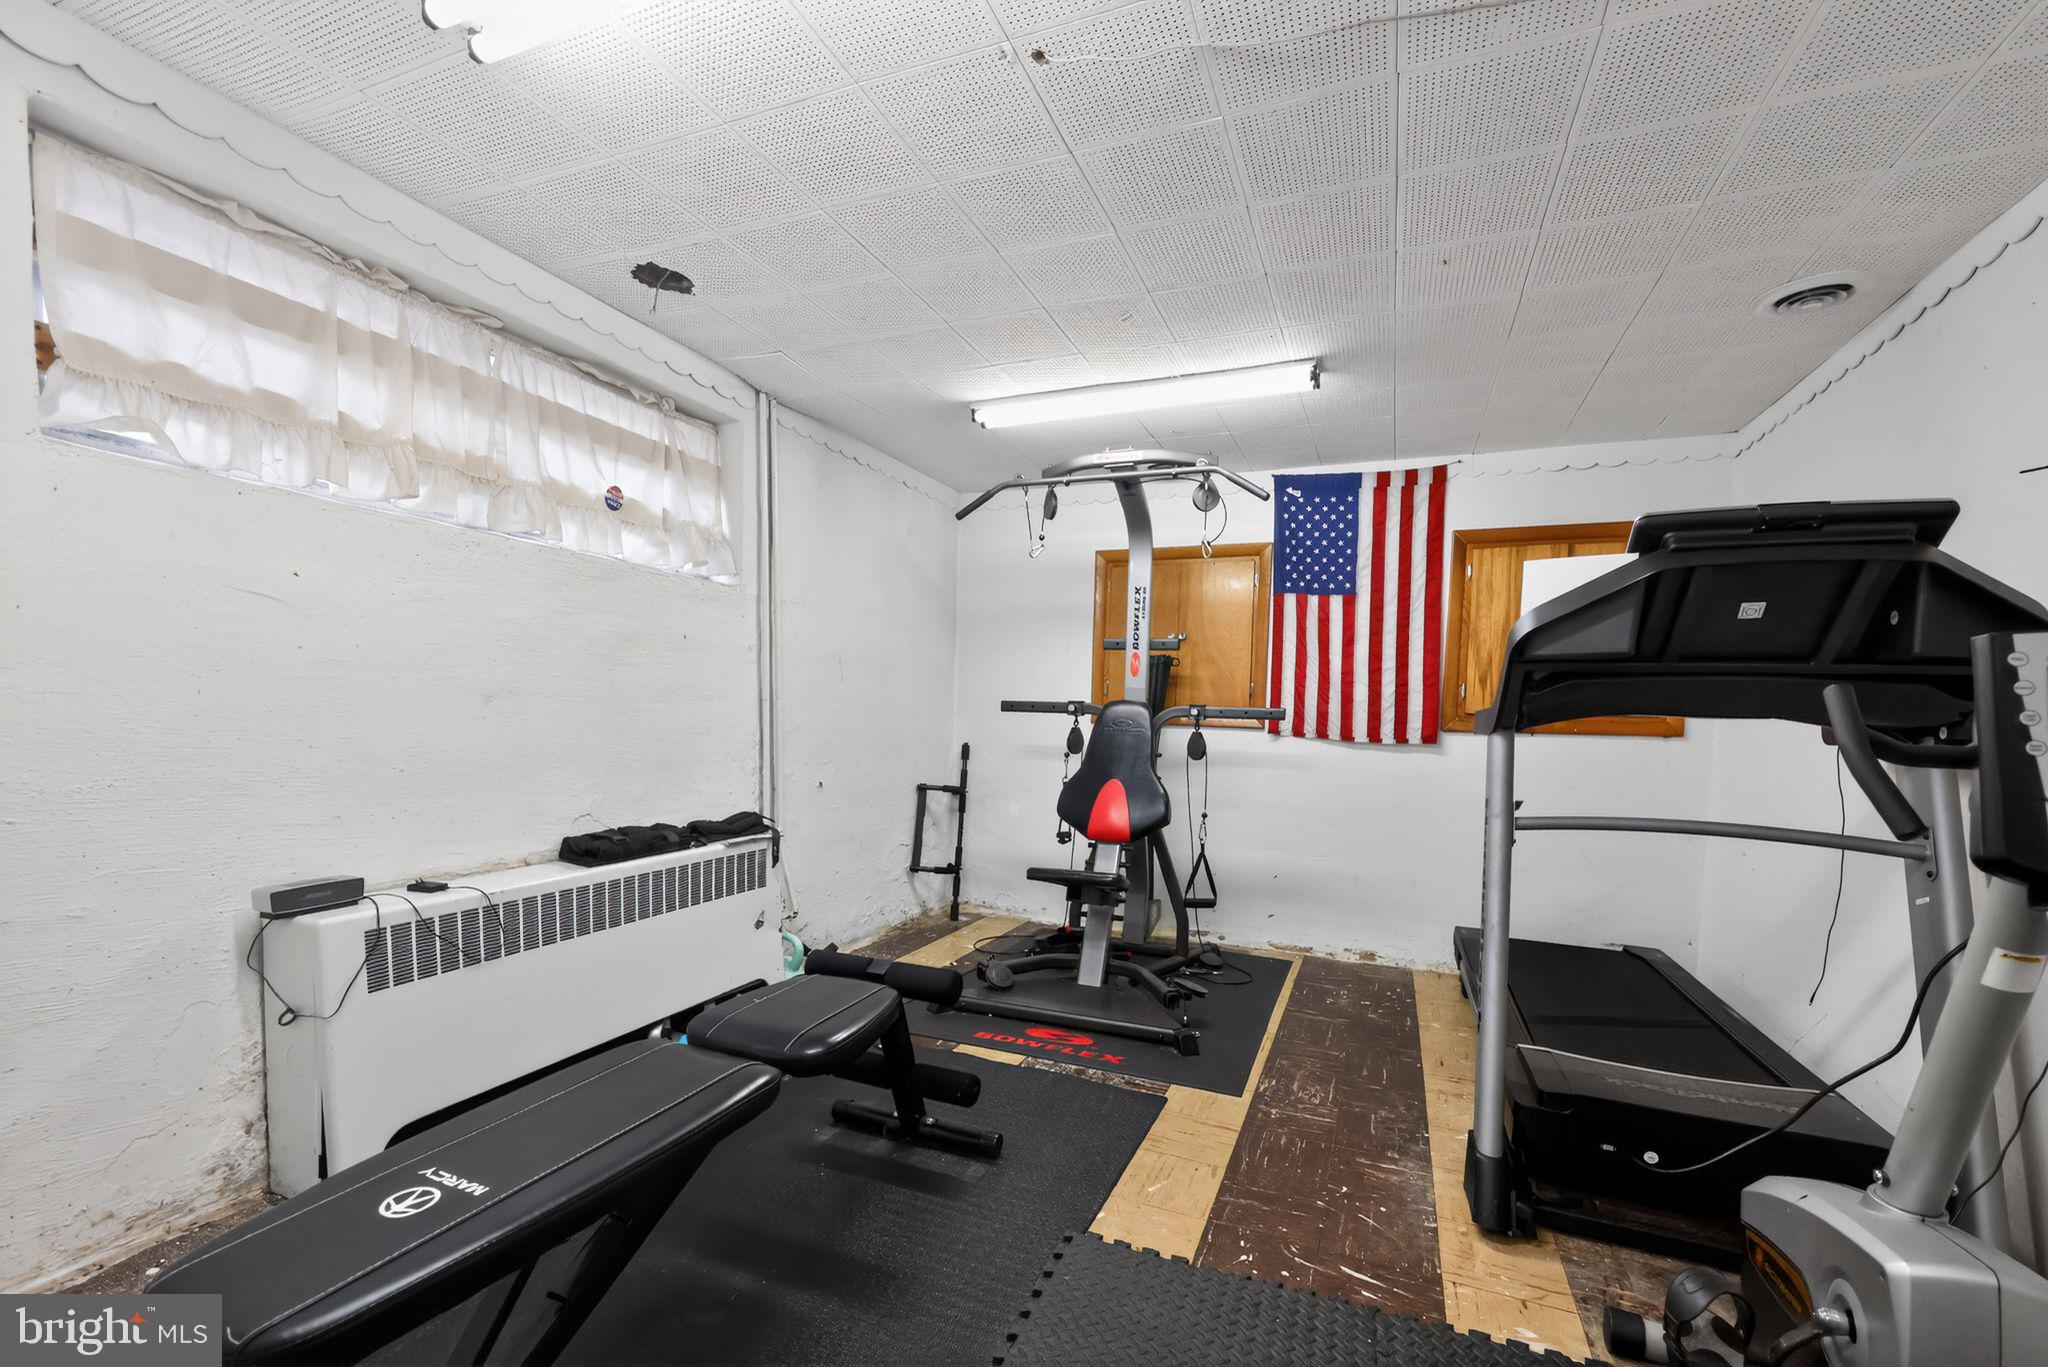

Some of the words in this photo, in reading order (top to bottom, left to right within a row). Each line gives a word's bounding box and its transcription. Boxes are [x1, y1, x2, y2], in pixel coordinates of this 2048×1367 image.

[1132, 586, 1142, 650] BOWFLEX
[973, 1031, 1125, 1064] BOWFLEX
[418, 1166, 490, 1197] MARCY
